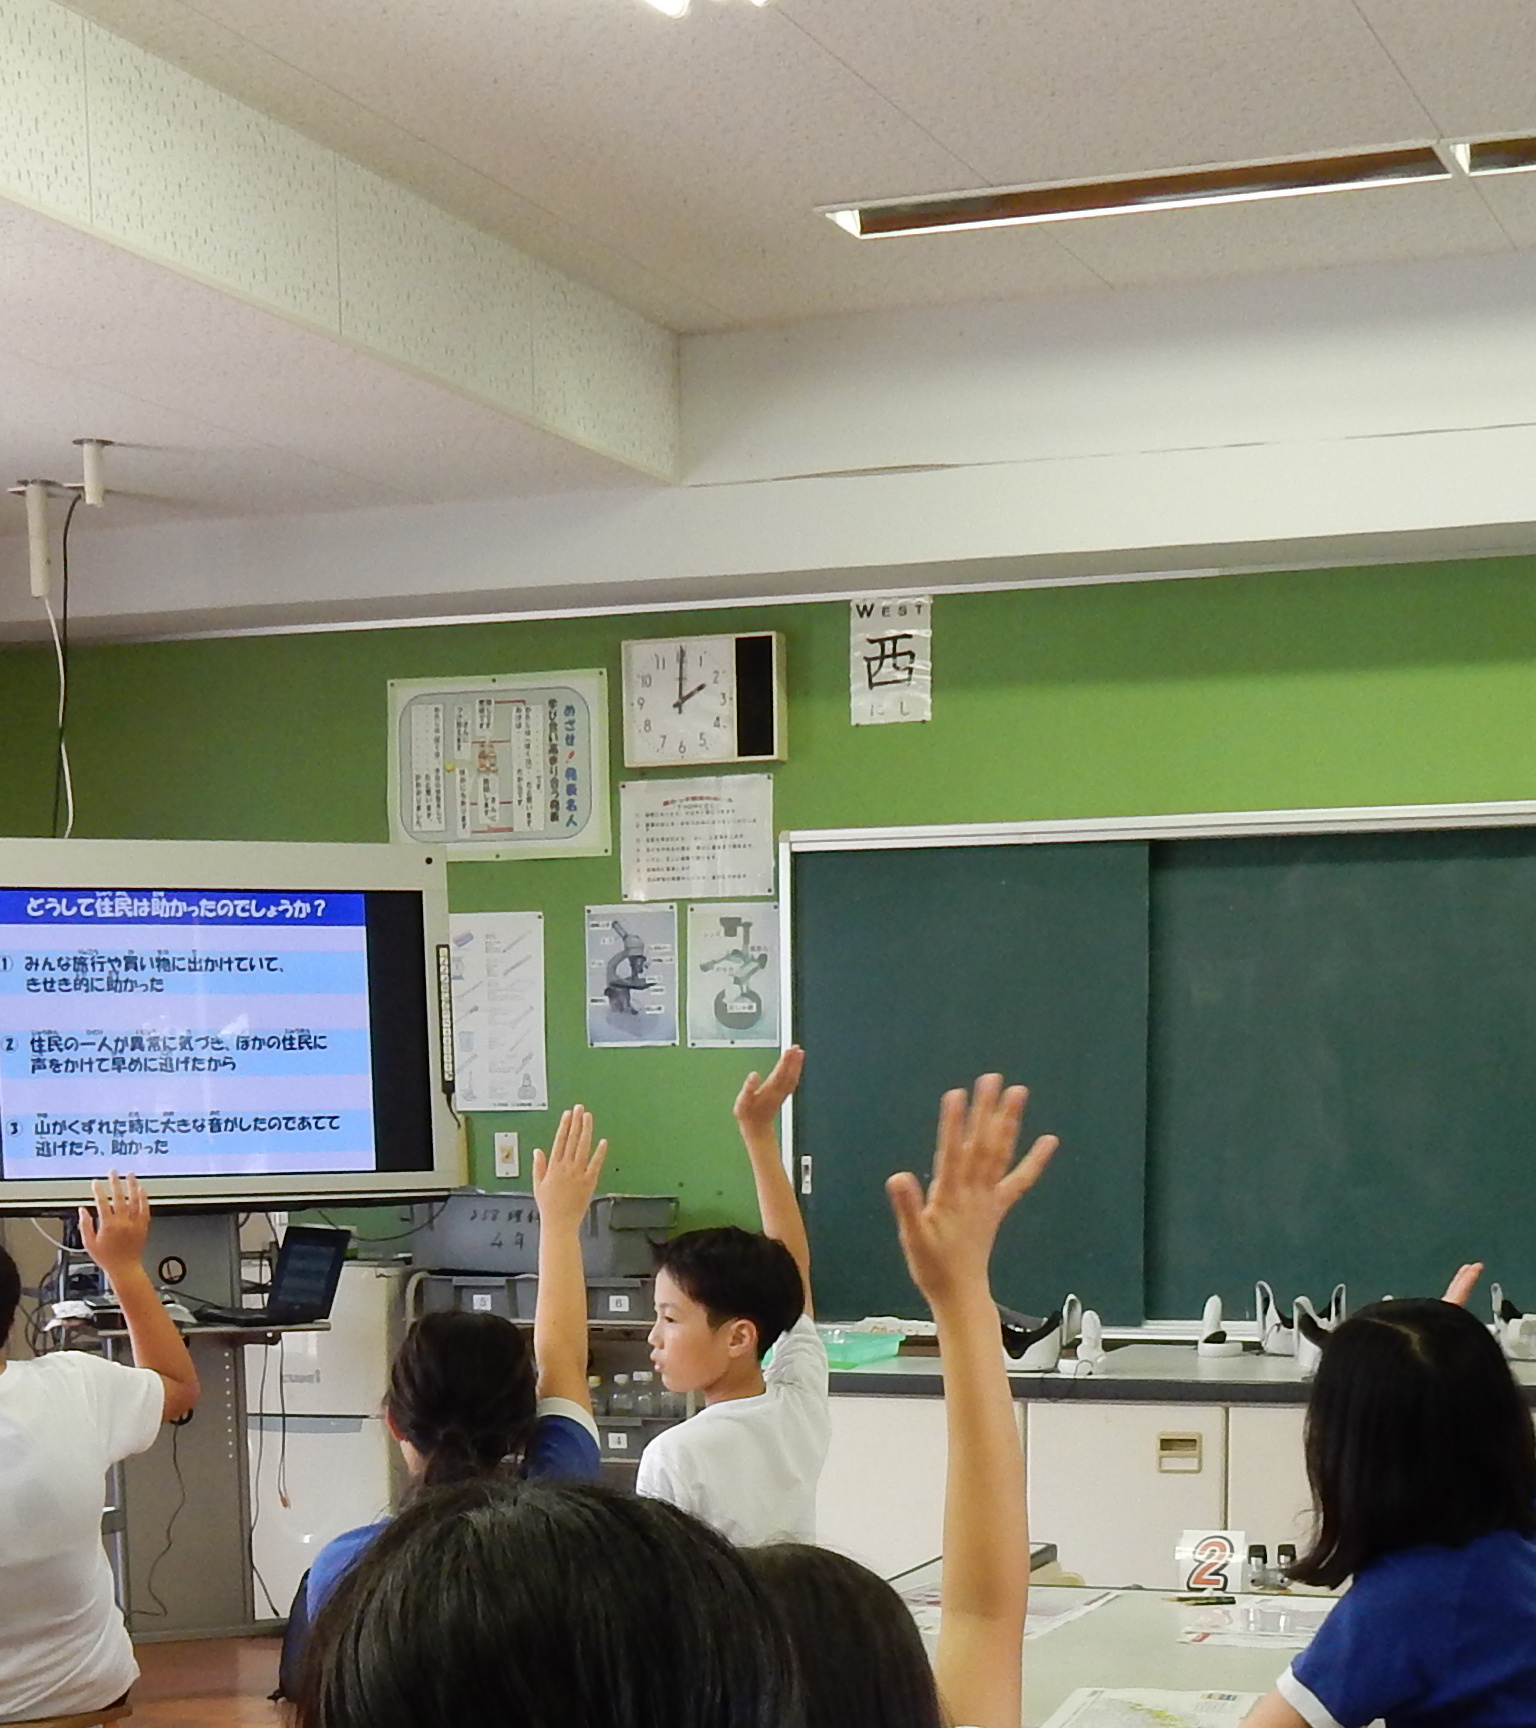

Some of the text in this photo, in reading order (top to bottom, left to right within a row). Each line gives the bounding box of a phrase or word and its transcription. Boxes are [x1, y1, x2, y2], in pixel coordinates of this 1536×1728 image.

[856, 603, 923, 618] WEST
[863, 633, 915, 690] 西
[712, 670, 720, 684] 2
[637, 697, 645, 710] 9
[720, 692, 727, 706] 3
[870, 701, 910, 716] にし
[644, 719, 652, 733] 8
[660, 735, 667, 749] 7
[678, 740, 686, 754] 6
[699, 732, 707, 747] 5
[26, 976, 165, 993] きせき的に助かった
[30, 1034, 328, 1054] 住民の一人が異常に気づき、ほかの住民に
[31, 1056, 236, 1074] 声をかけて早めに逃げたから
[35, 1138, 169, 1157] 逃げたら、助かった
[1186, 1535, 1234, 1592] 2
